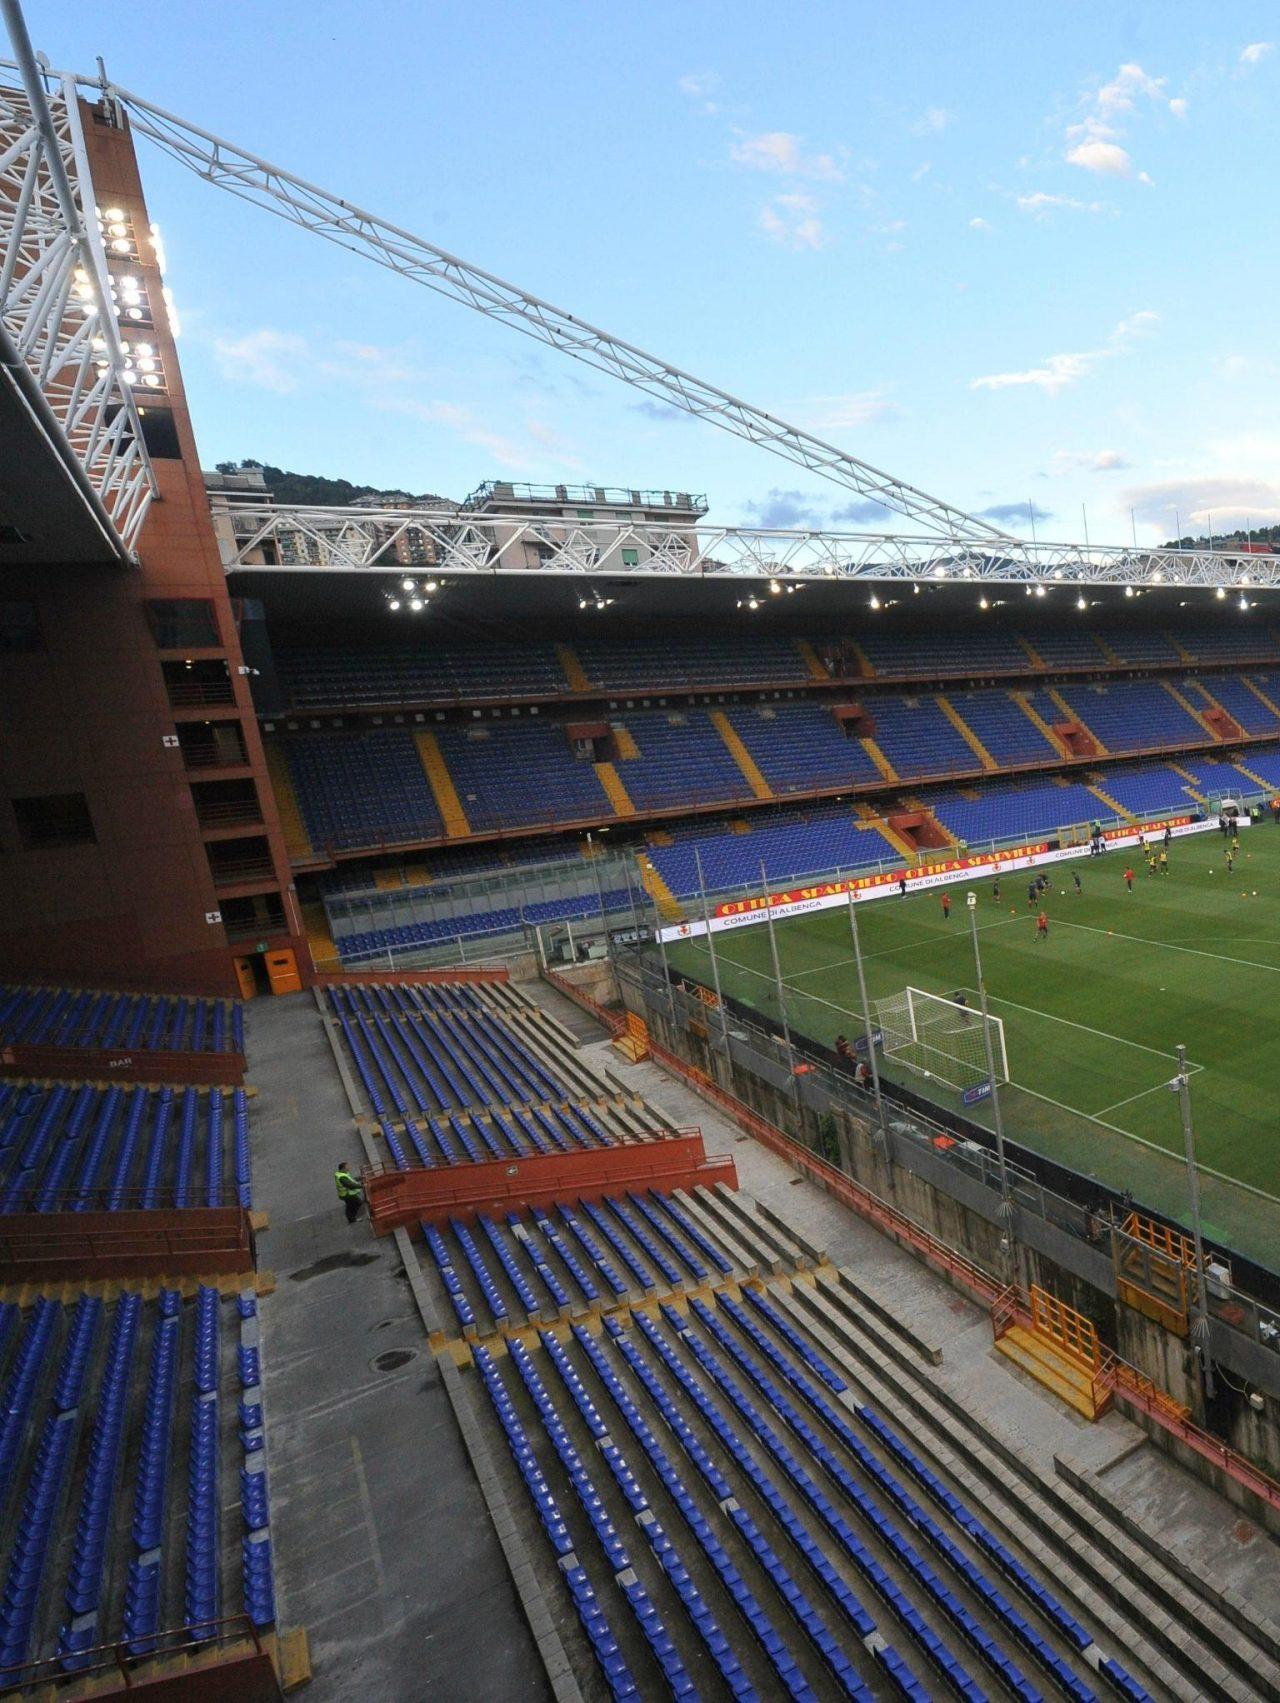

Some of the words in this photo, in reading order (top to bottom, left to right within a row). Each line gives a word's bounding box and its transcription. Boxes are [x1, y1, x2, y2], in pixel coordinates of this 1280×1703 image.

[905, 861, 962, 879] OTTICA
[967, 844, 1046, 867] SPARVIERO
[1055, 848, 1083, 859] COMUNE
[934, 871, 970, 883] ALBENGA
[721, 894, 793, 915] OTTICA
[800, 873, 898, 899] SPARVIERO
[723, 911, 768, 926] COMUNE
[780, 900, 823, 914] ALBENGA
[977, 1085, 991, 1096] TIM
